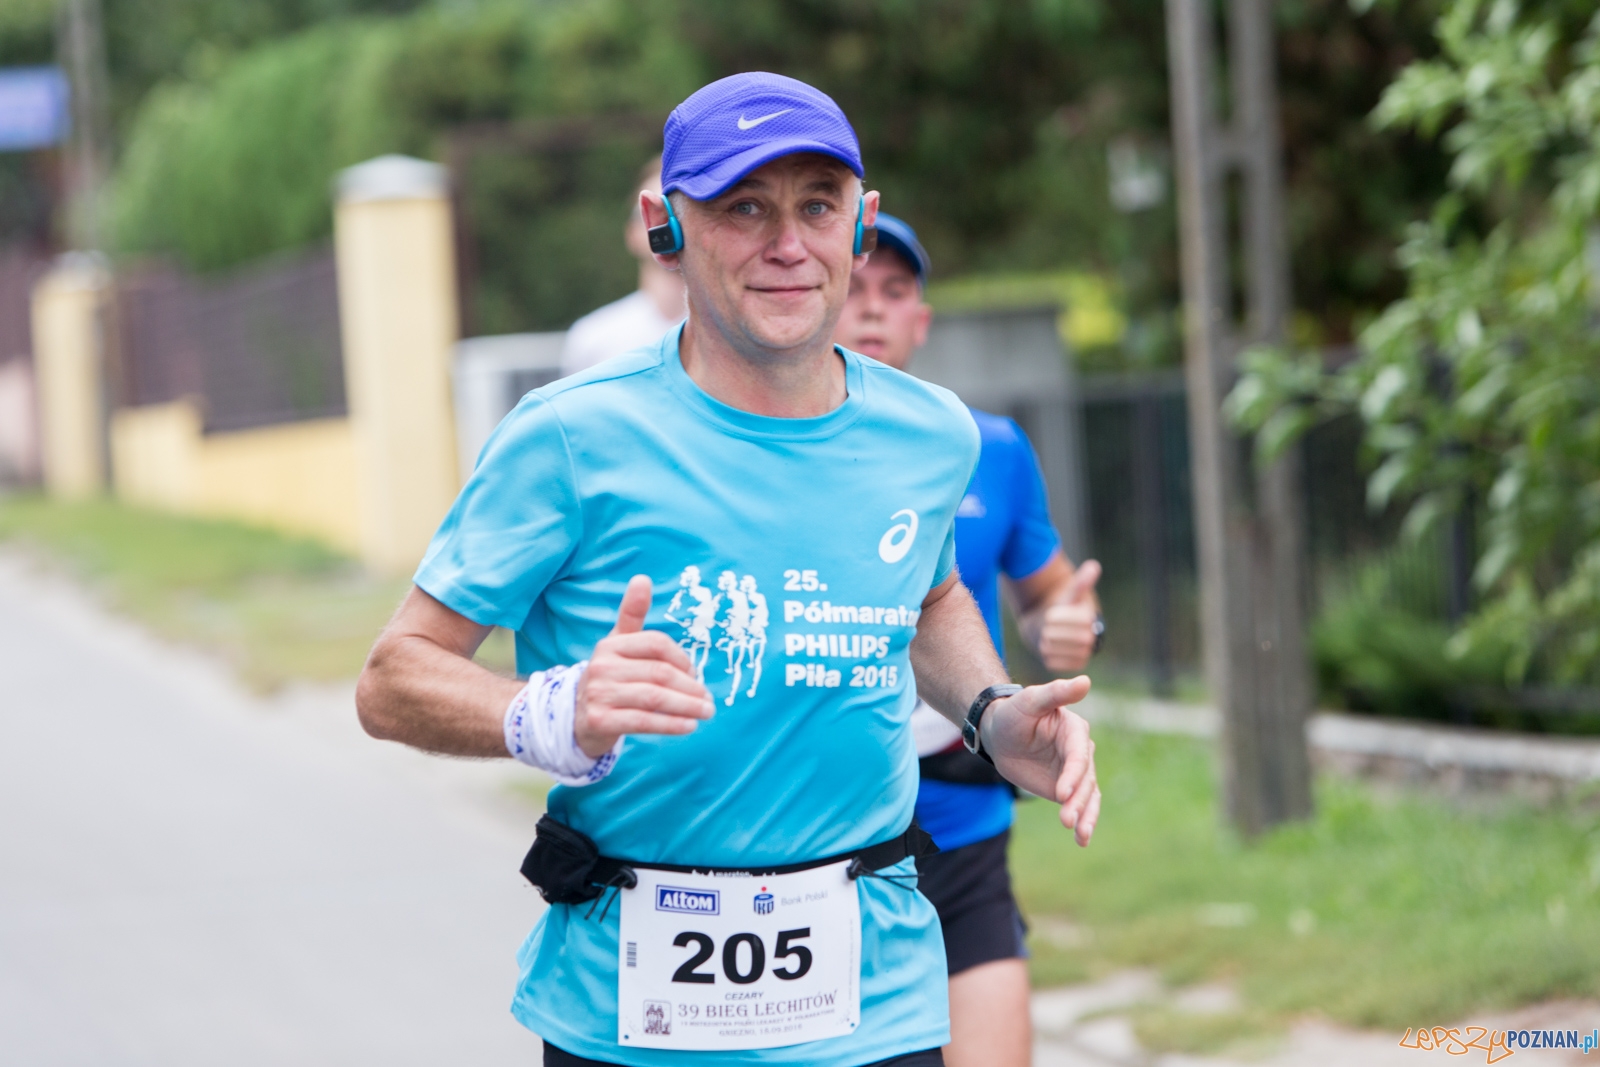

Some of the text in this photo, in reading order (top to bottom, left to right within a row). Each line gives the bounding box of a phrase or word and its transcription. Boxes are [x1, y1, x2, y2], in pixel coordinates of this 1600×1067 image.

[783, 569, 828, 592] 25.
[784, 633, 891, 659] PHILIPS
[785, 664, 898, 688] Piła 2015
[780, 889, 829, 907] Bank Polski
[671, 926, 813, 985] 205
[678, 989, 838, 1020] 39 BIEG LECHITÓW
[724, 991, 765, 1001] CEZARY
